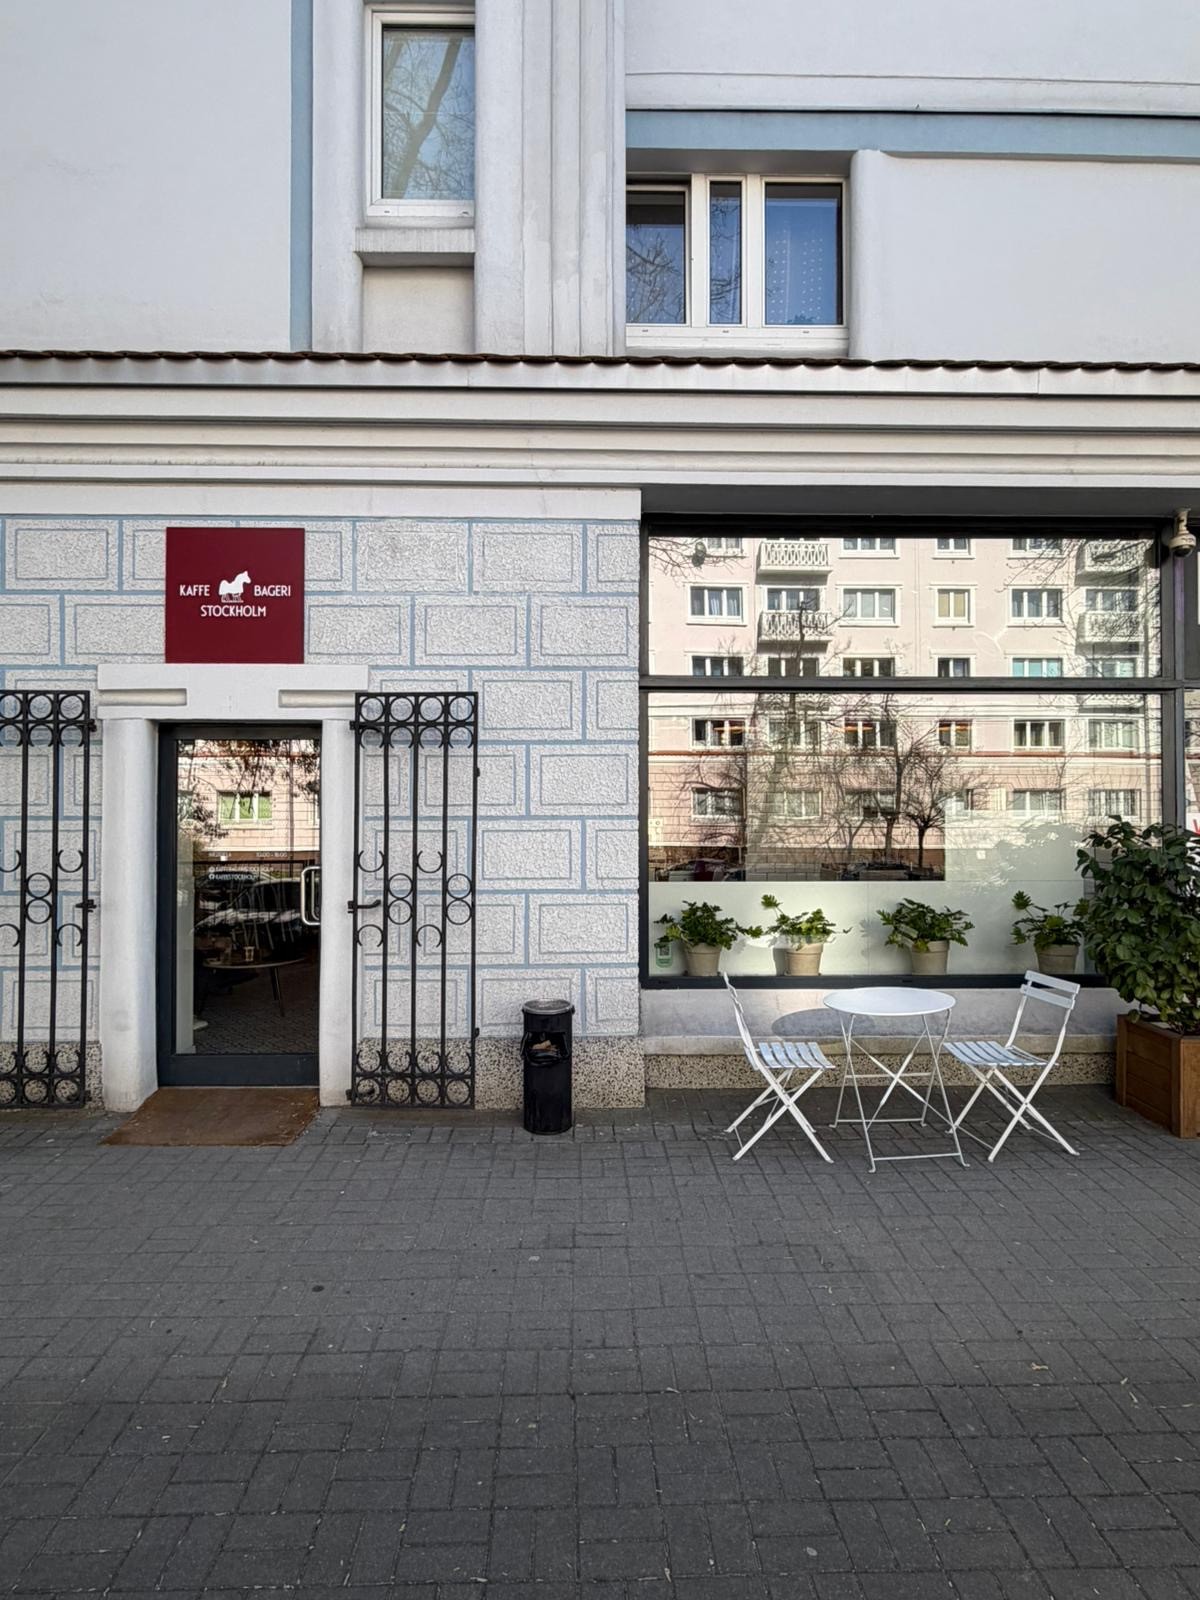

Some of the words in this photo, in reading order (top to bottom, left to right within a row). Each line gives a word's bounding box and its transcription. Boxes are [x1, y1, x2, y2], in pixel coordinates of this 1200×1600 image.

[179, 584, 210, 597] KAFFE
[253, 584, 291, 597] BAGERI
[200, 604, 267, 617] STOCKHOLM
